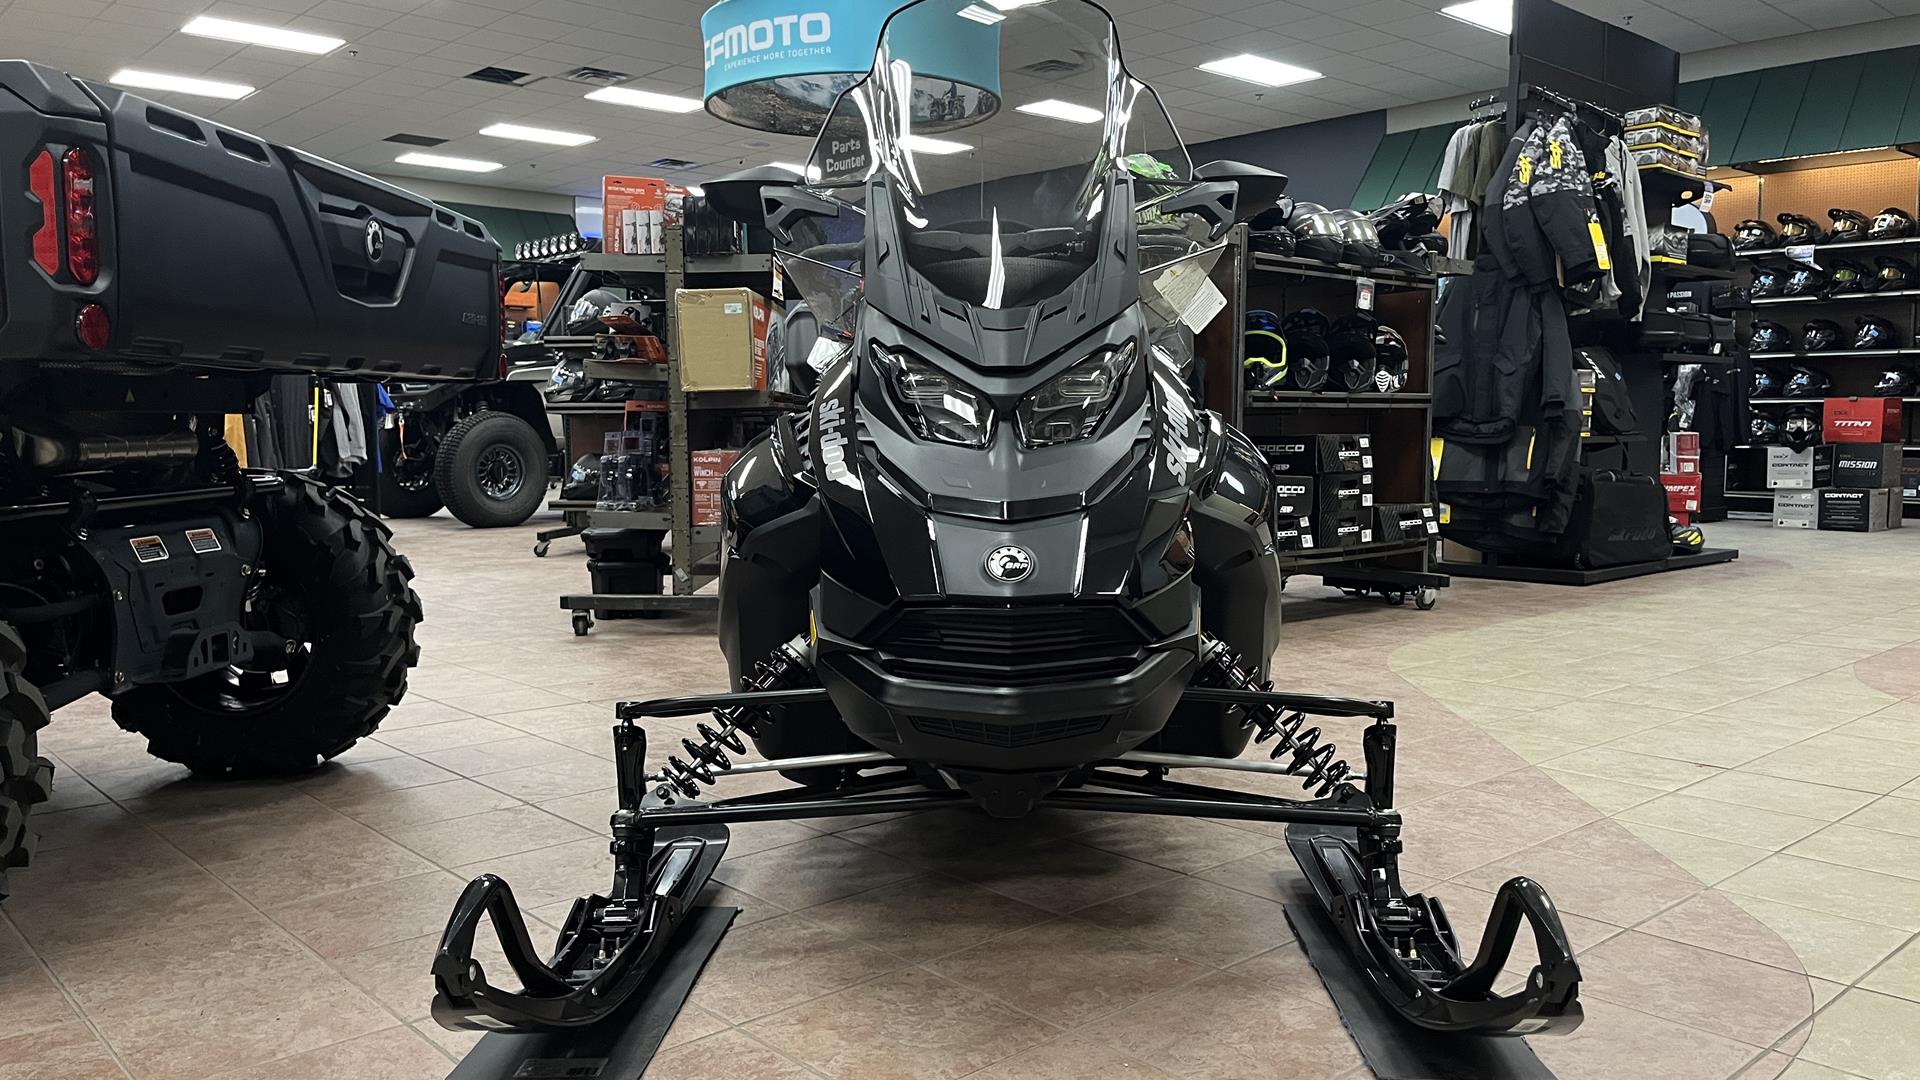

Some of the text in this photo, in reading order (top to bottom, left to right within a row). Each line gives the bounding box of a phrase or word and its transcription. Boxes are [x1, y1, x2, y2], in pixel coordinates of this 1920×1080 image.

[724, 46, 832, 71] EXPERIENCE MORE TOGETHER
[831, 138, 861, 155] Parts
[826, 154, 866, 173] Counter
[819, 398, 849, 482] ski-doo
[1163, 390, 1200, 487] ski-doo
[1838, 460, 1878, 469] MISSION
[1276, 485, 1306, 494] OCCO
